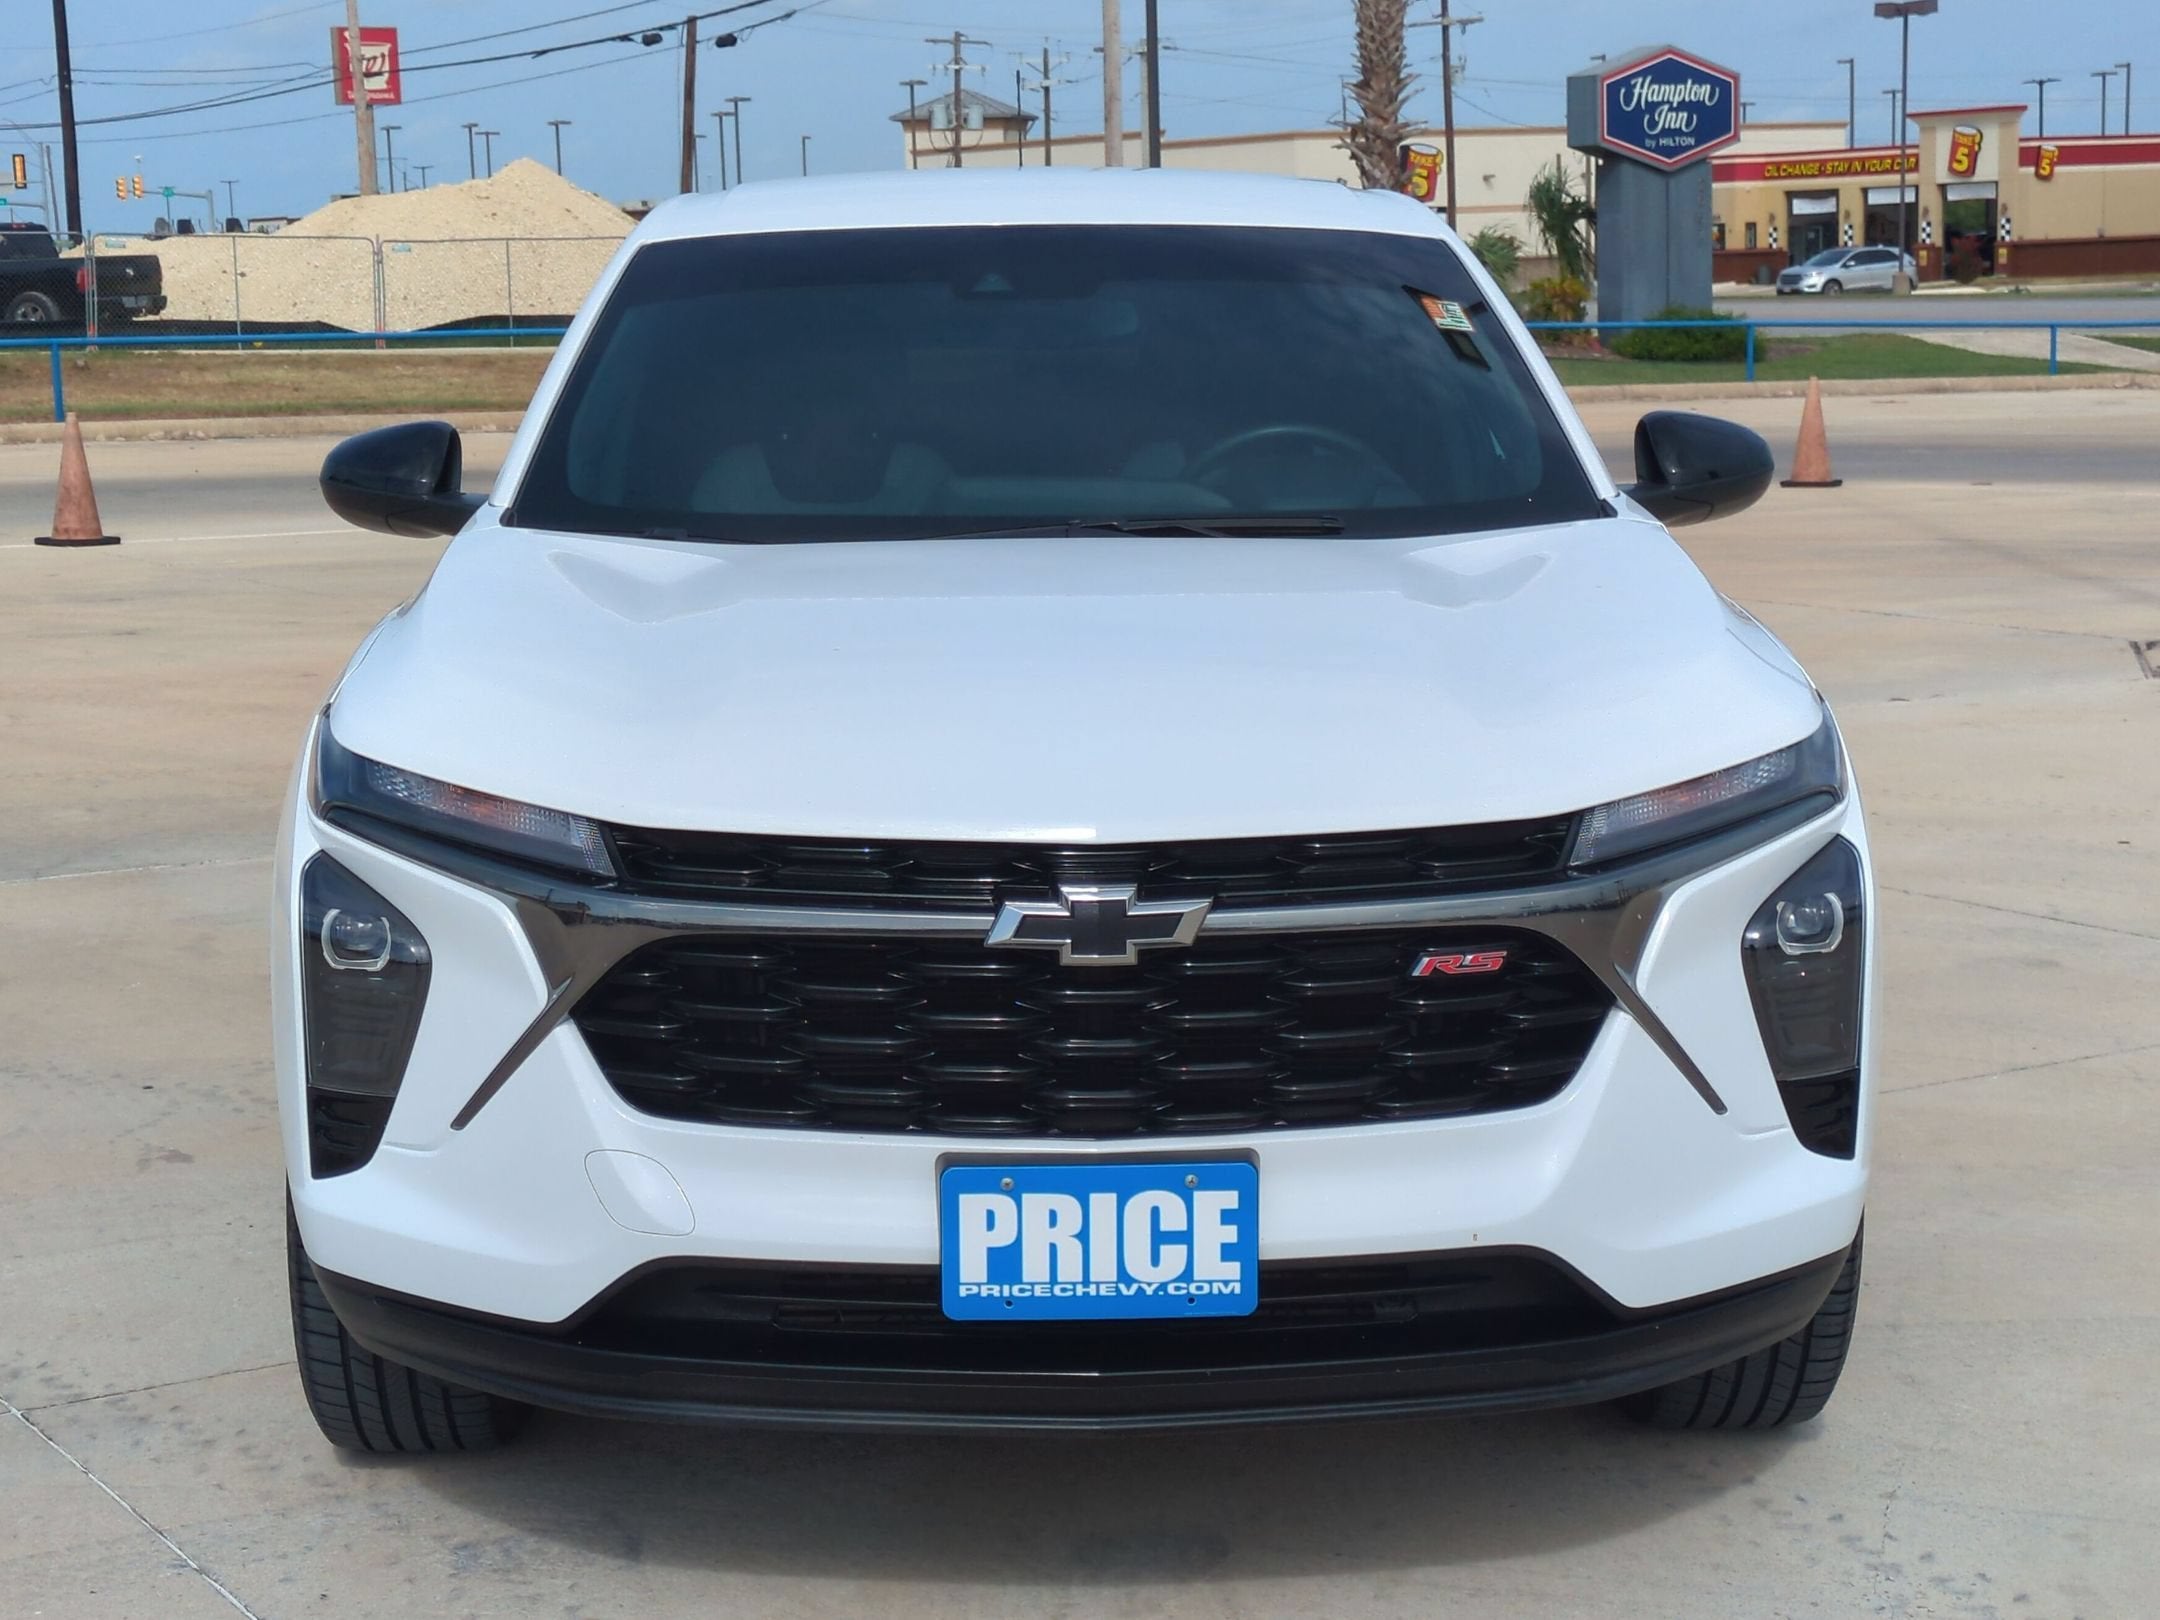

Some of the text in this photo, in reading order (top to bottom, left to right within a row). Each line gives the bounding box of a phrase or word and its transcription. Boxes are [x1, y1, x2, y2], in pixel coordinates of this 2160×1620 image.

[1619, 75, 1720, 112] Hampton
[1643, 105, 1697, 135] Inn
[1644, 136, 1695, 149] by HILTON
[1765, 165, 1779, 177] OIL
[1780, 162, 1820, 176] CHANGE
[1825, 160, 1850, 174] STAY
[1851, 159, 1861, 173] IN
[1864, 158, 1892, 172] YOUR
[1952, 146, 1968, 172] 5
[2040, 158, 2050, 176] 5
[1411, 950, 1508, 977] RS
[958, 1189, 1242, 1283] PRICE
[958, 1281, 1242, 1297] PRICECHEVY.COM
